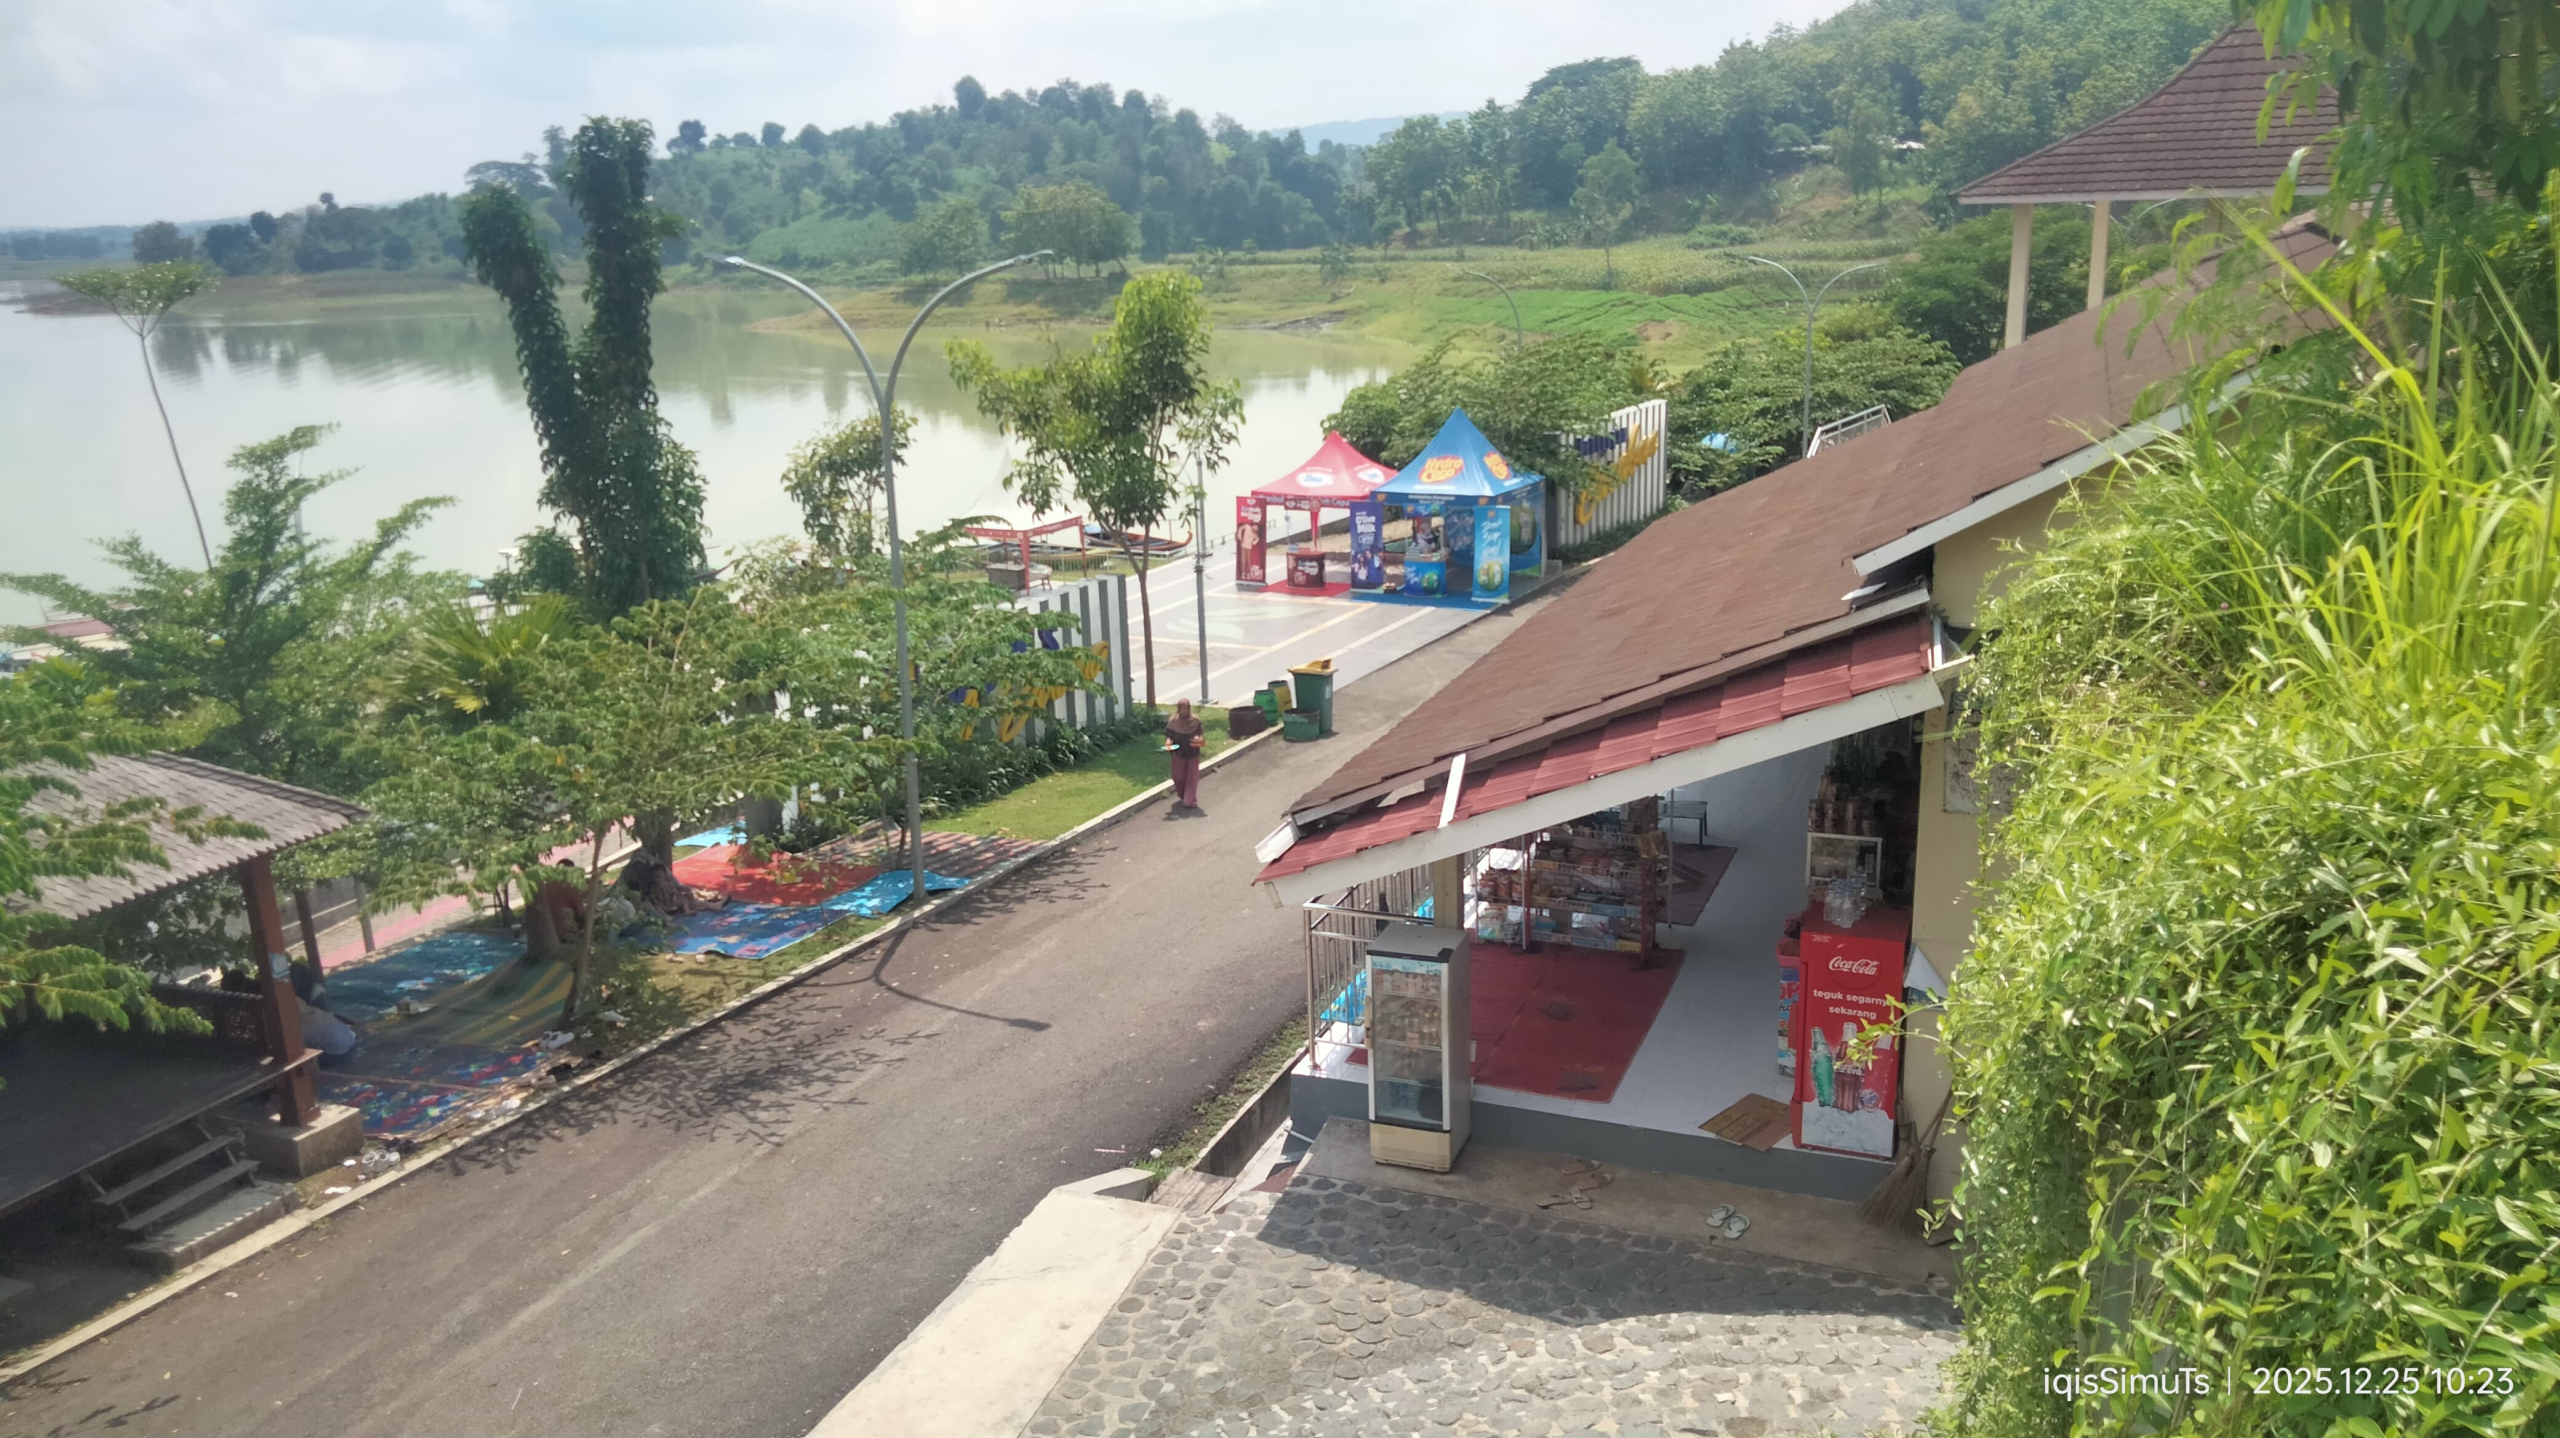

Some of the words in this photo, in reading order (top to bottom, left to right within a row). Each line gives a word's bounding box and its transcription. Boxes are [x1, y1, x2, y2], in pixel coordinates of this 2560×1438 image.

[1425, 457, 1464, 473] Hydro
[1420, 468, 1455, 483] Coco
[1813, 989, 1844, 1001] teguk
[1846, 994, 1888, 1007] segarny
[1829, 1005, 1877, 1020] sekarang
